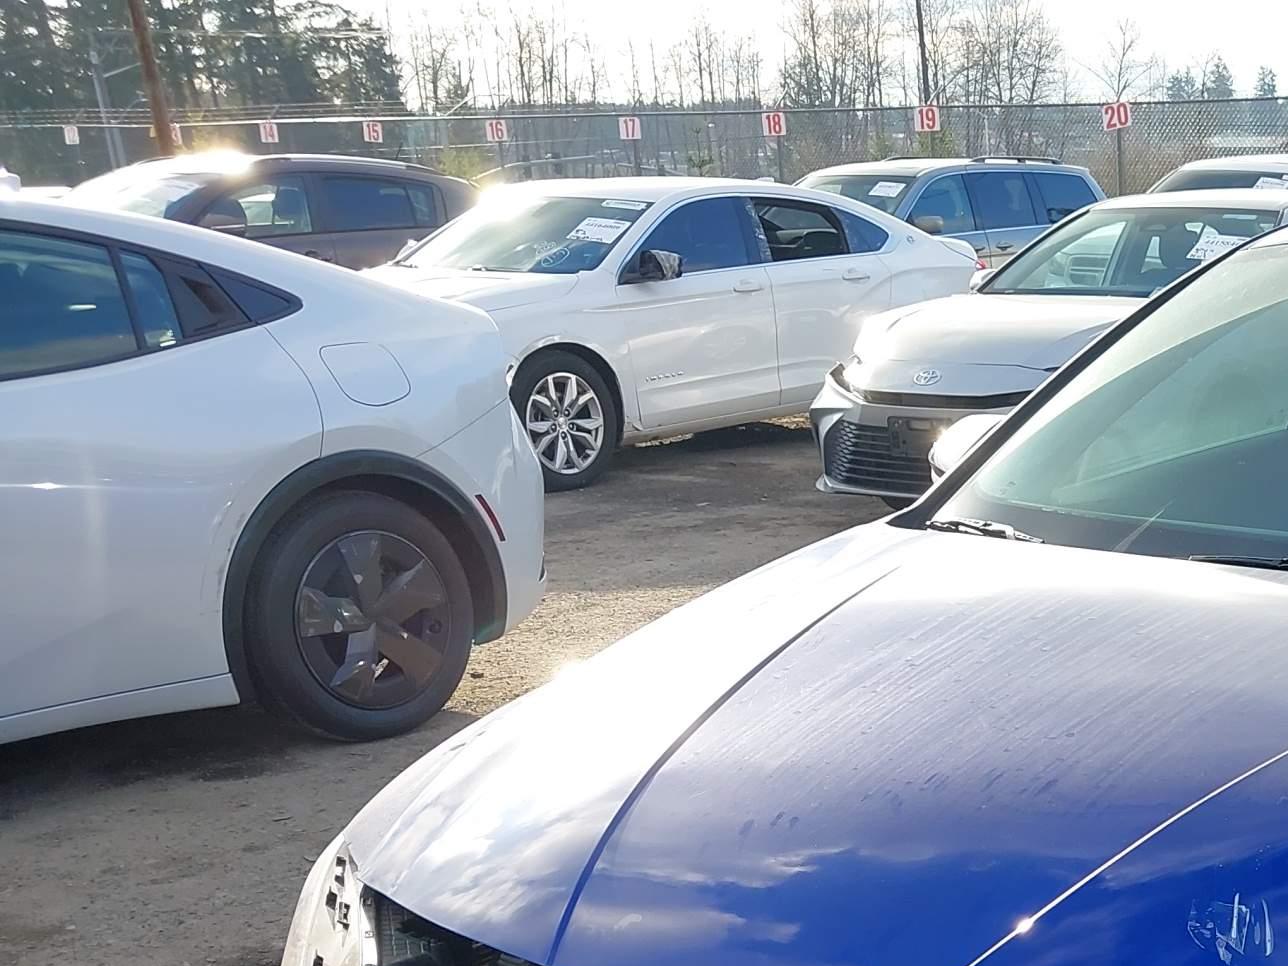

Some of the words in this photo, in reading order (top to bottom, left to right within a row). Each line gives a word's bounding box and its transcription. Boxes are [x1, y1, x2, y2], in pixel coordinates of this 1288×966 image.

[766, 112, 782, 134] 18
[919, 107, 937, 130] 19
[1103, 104, 1129, 128] 20
[264, 123, 274, 141] 14
[367, 123, 379, 141] 15
[489, 120, 504, 140] 16
[623, 118, 636, 138] 17
